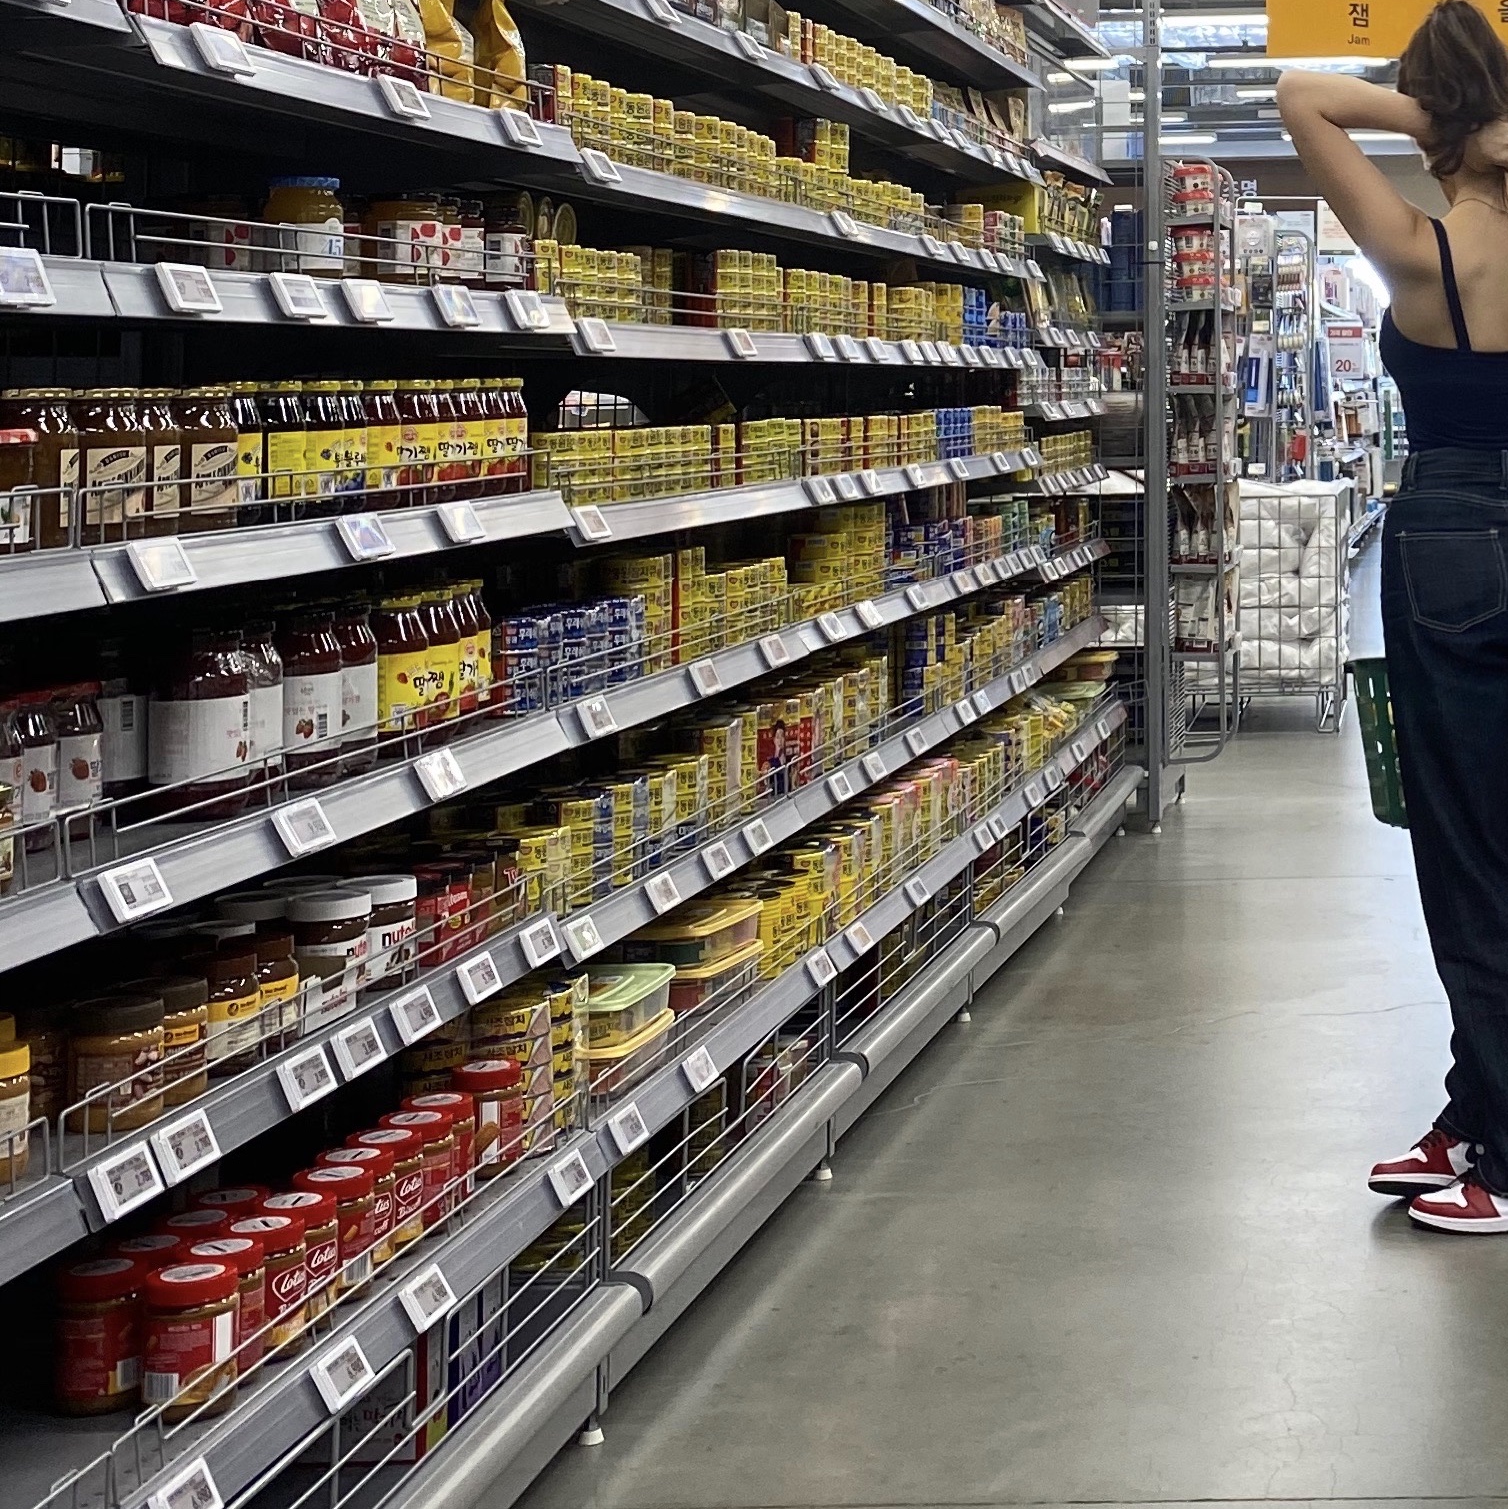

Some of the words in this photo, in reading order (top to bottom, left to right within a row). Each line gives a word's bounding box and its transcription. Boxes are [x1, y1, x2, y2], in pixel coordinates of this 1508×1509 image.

[1347, 2, 1370, 28] 잼
[1347, 33, 1371, 46] Jam
[1335, 359, 1352, 372] 20
